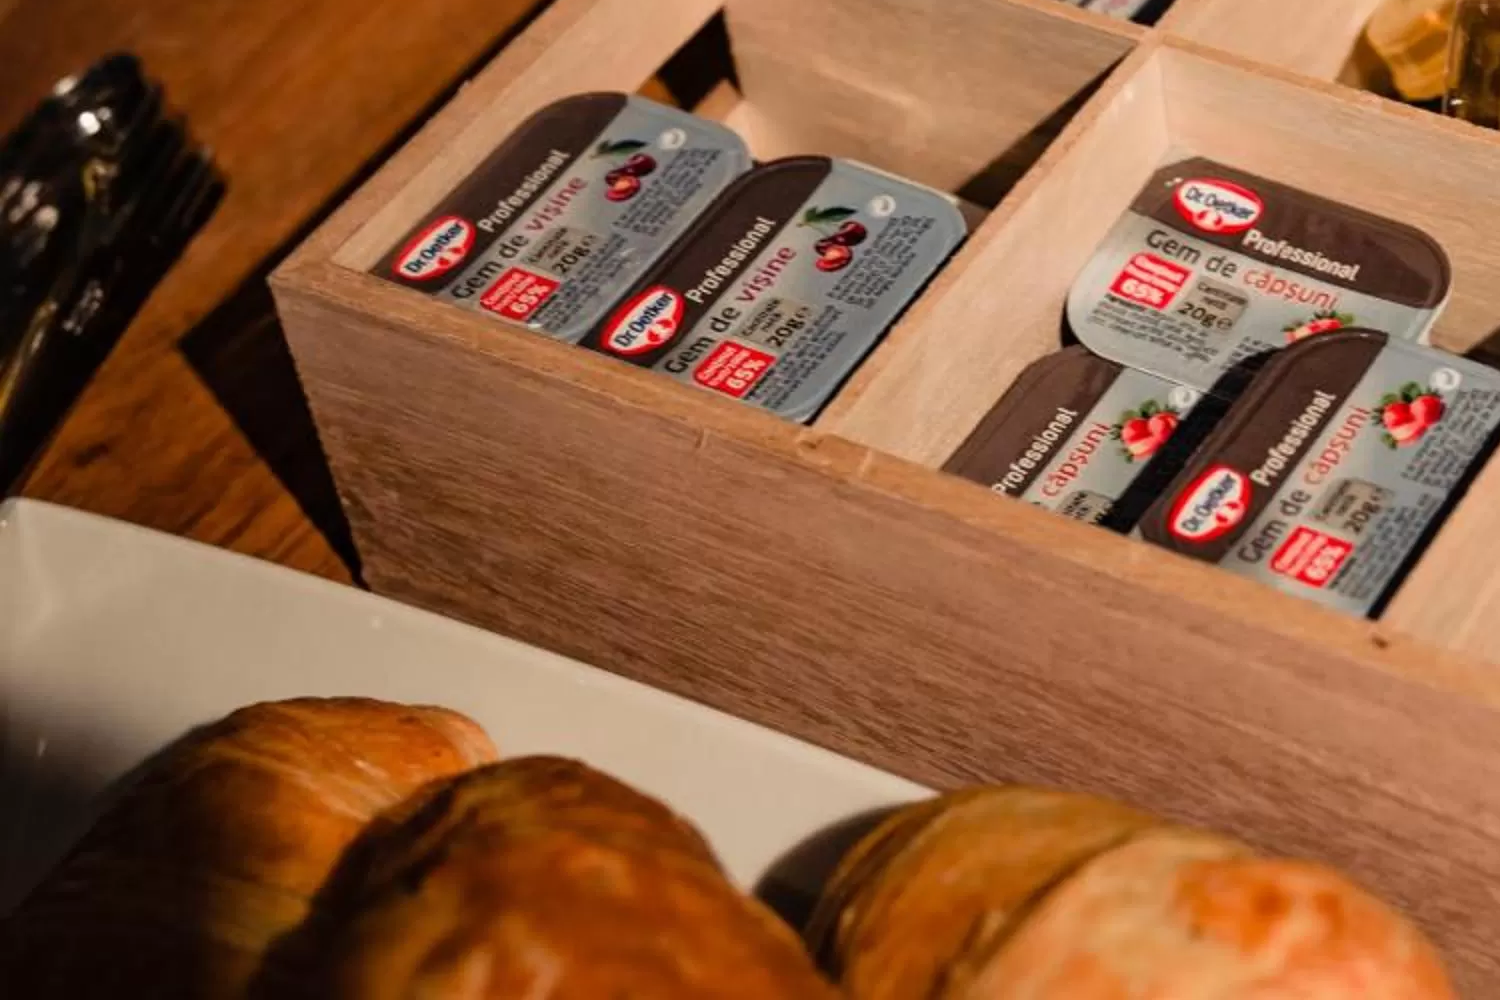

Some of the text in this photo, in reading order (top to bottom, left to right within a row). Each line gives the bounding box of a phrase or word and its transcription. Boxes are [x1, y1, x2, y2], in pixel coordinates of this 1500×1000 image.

[477, 149, 571, 233] Professional
[452, 259, 501, 299] Gem
[499, 235, 530, 260] de
[684, 216, 776, 304] Professional
[1146, 229, 1201, 265] Gem
[1204, 254, 1238, 279] de
[1242, 228, 1360, 282] Professional
[664, 335, 715, 375] Gem
[711, 306, 742, 333] de
[1250, 389, 1337, 487] Professional
[1237, 520, 1283, 563] Gem
[1280, 490, 1312, 517] de
